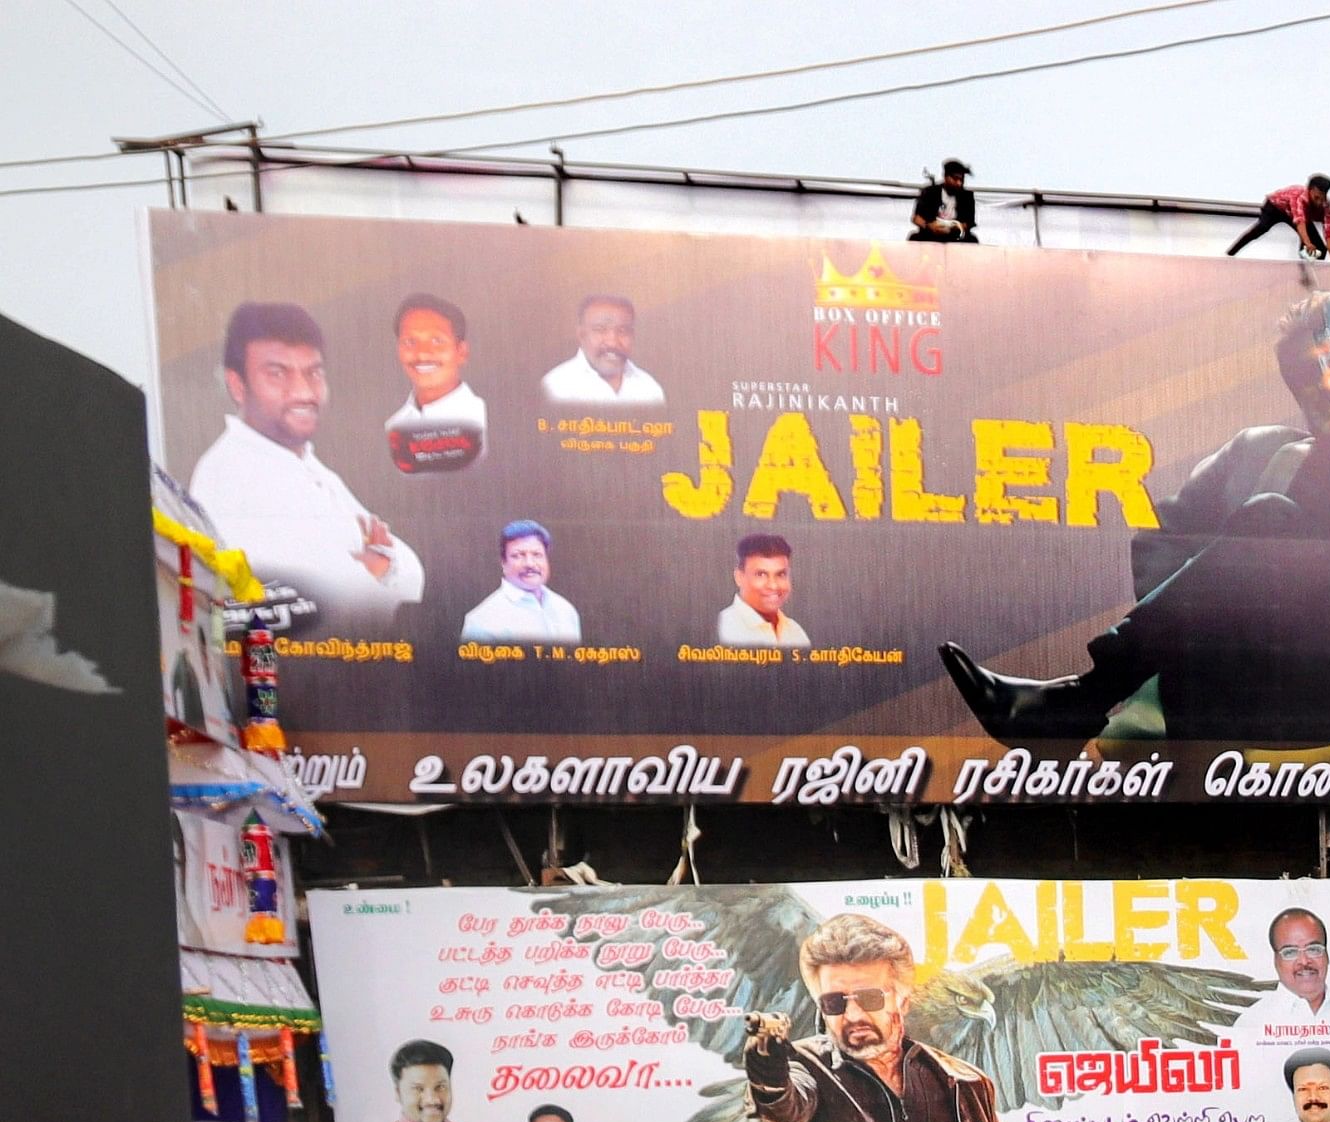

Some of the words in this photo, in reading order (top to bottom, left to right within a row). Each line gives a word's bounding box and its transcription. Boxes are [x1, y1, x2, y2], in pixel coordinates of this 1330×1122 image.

[814, 307, 855, 321] BOX
[865, 309, 941, 327] OFFICE
[814, 326, 943, 376] KING
[732, 381, 810, 393] SUPERSTAR
[733, 392, 898, 412] RAJINIKANTH
[661, 409, 1162, 529] JAILER
[458, 643, 524, 662] விருகை
[676, 643, 782, 664] சிவலிங்கபுரம்
[409, 745, 744, 796] உலகளாவிய
[771, 745, 930, 804] ரஜினி
[952, 748, 1173, 805] ரசிகர்கள்
[909, 880, 1248, 988] JAILER
[1040, 1037, 1241, 1096] ஜெயிலர்
